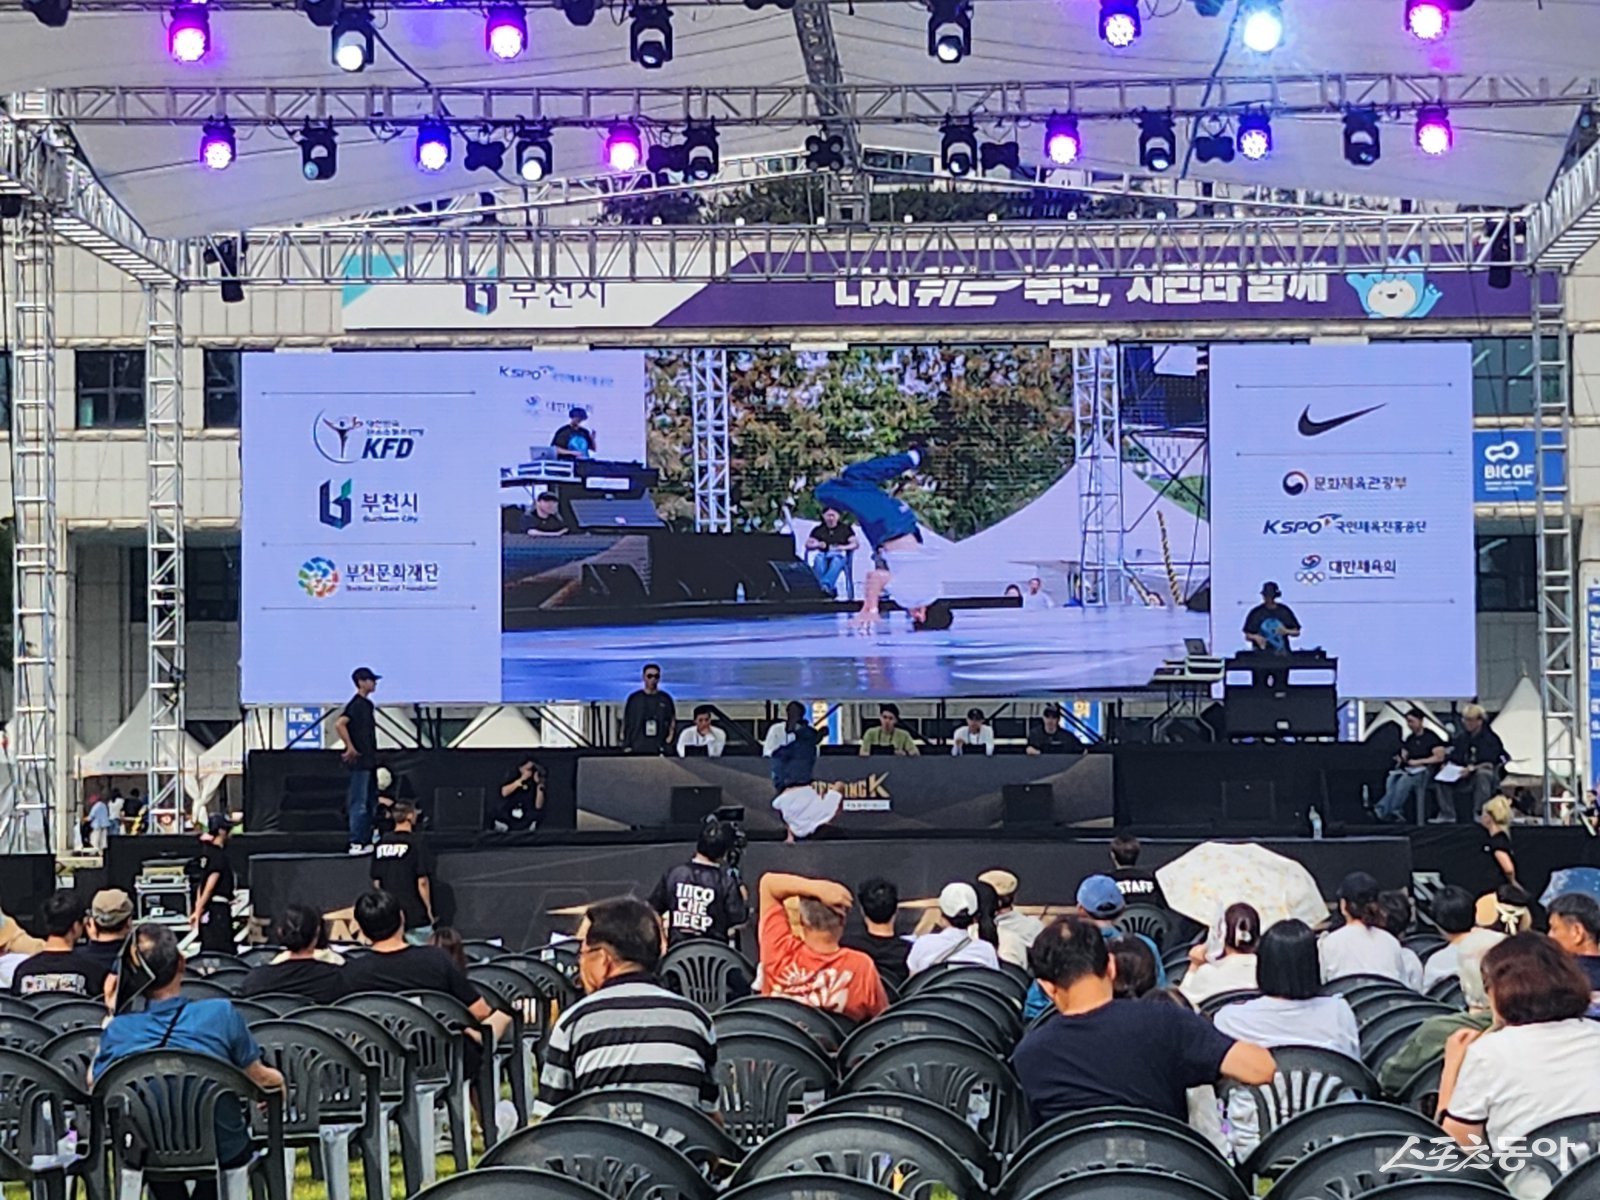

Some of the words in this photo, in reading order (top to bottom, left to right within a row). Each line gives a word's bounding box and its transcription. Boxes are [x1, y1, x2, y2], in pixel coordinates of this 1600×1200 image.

[361, 438, 414, 459] KFD
[1484, 463, 1535, 479] BICOF
[1314, 476, 1407, 491] 문화체육관광부
[361, 493, 418, 513] 부천시
[1263, 519, 1322, 534] KSPO
[346, 563, 438, 582] 부천문화재단
[672, 910, 713, 932] DEEP
